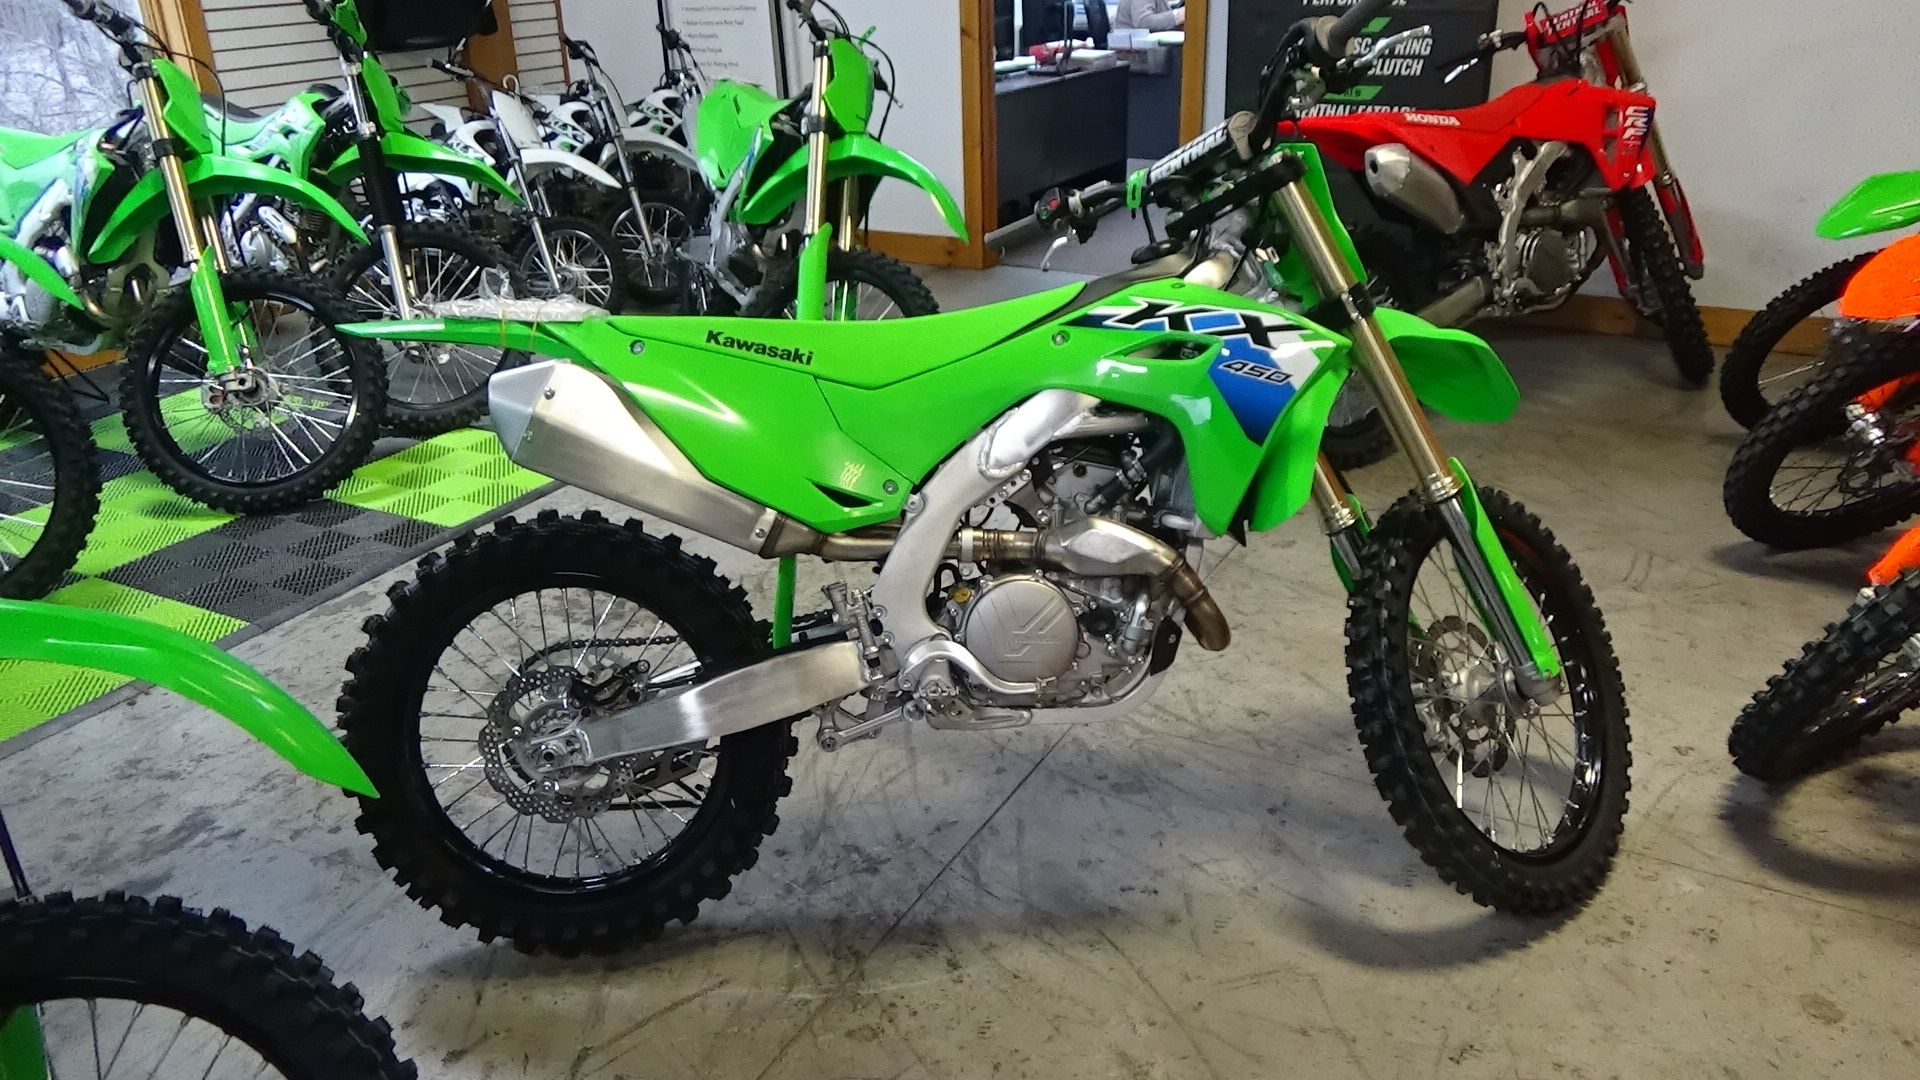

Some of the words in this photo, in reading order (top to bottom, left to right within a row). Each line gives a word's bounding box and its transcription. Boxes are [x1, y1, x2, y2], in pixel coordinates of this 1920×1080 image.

[1403, 112, 1461, 127] HONDA
[1150, 128, 1228, 185] RENTHAL
[705, 329, 814, 366] Kawasaki
[1220, 360, 1293, 384] 450
